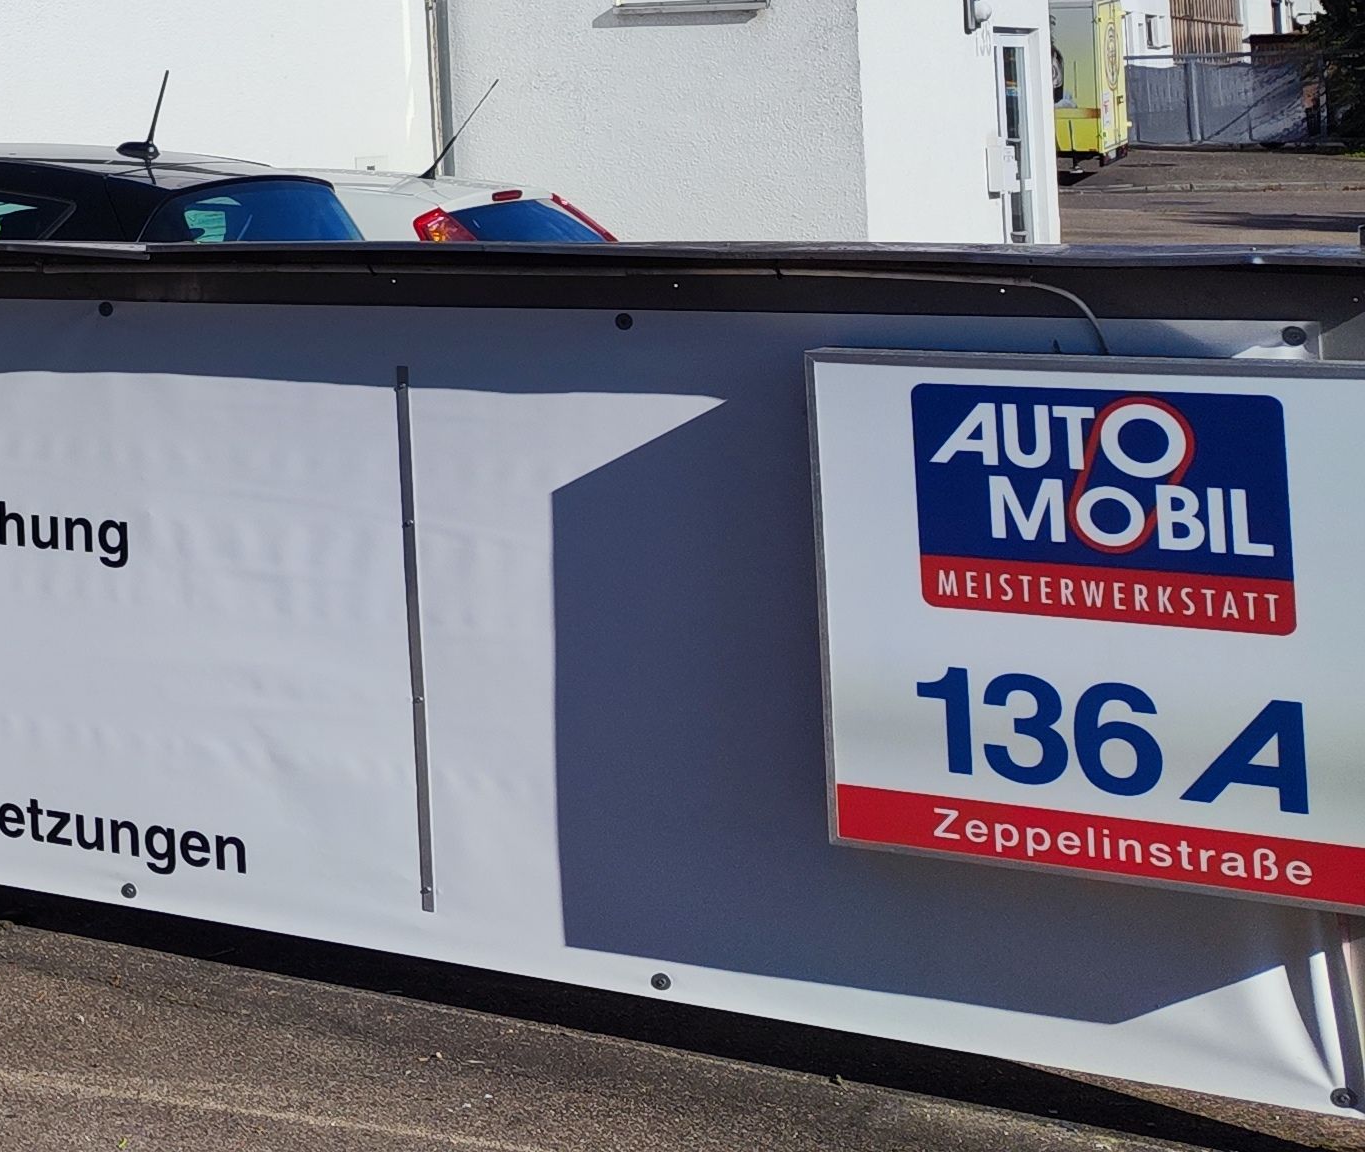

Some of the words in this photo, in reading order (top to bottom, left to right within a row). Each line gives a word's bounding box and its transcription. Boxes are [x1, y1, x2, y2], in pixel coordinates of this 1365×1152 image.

[929, 401, 1186, 478] AUTO
[988, 475, 1276, 558] MOBIL
[937, 569, 1280, 623] MEISTERWERKSTATT
[916, 666, 1164, 797] 136
[1179, 699, 1310, 815] A
[932, 807, 1314, 887] Zeppelinstraße
